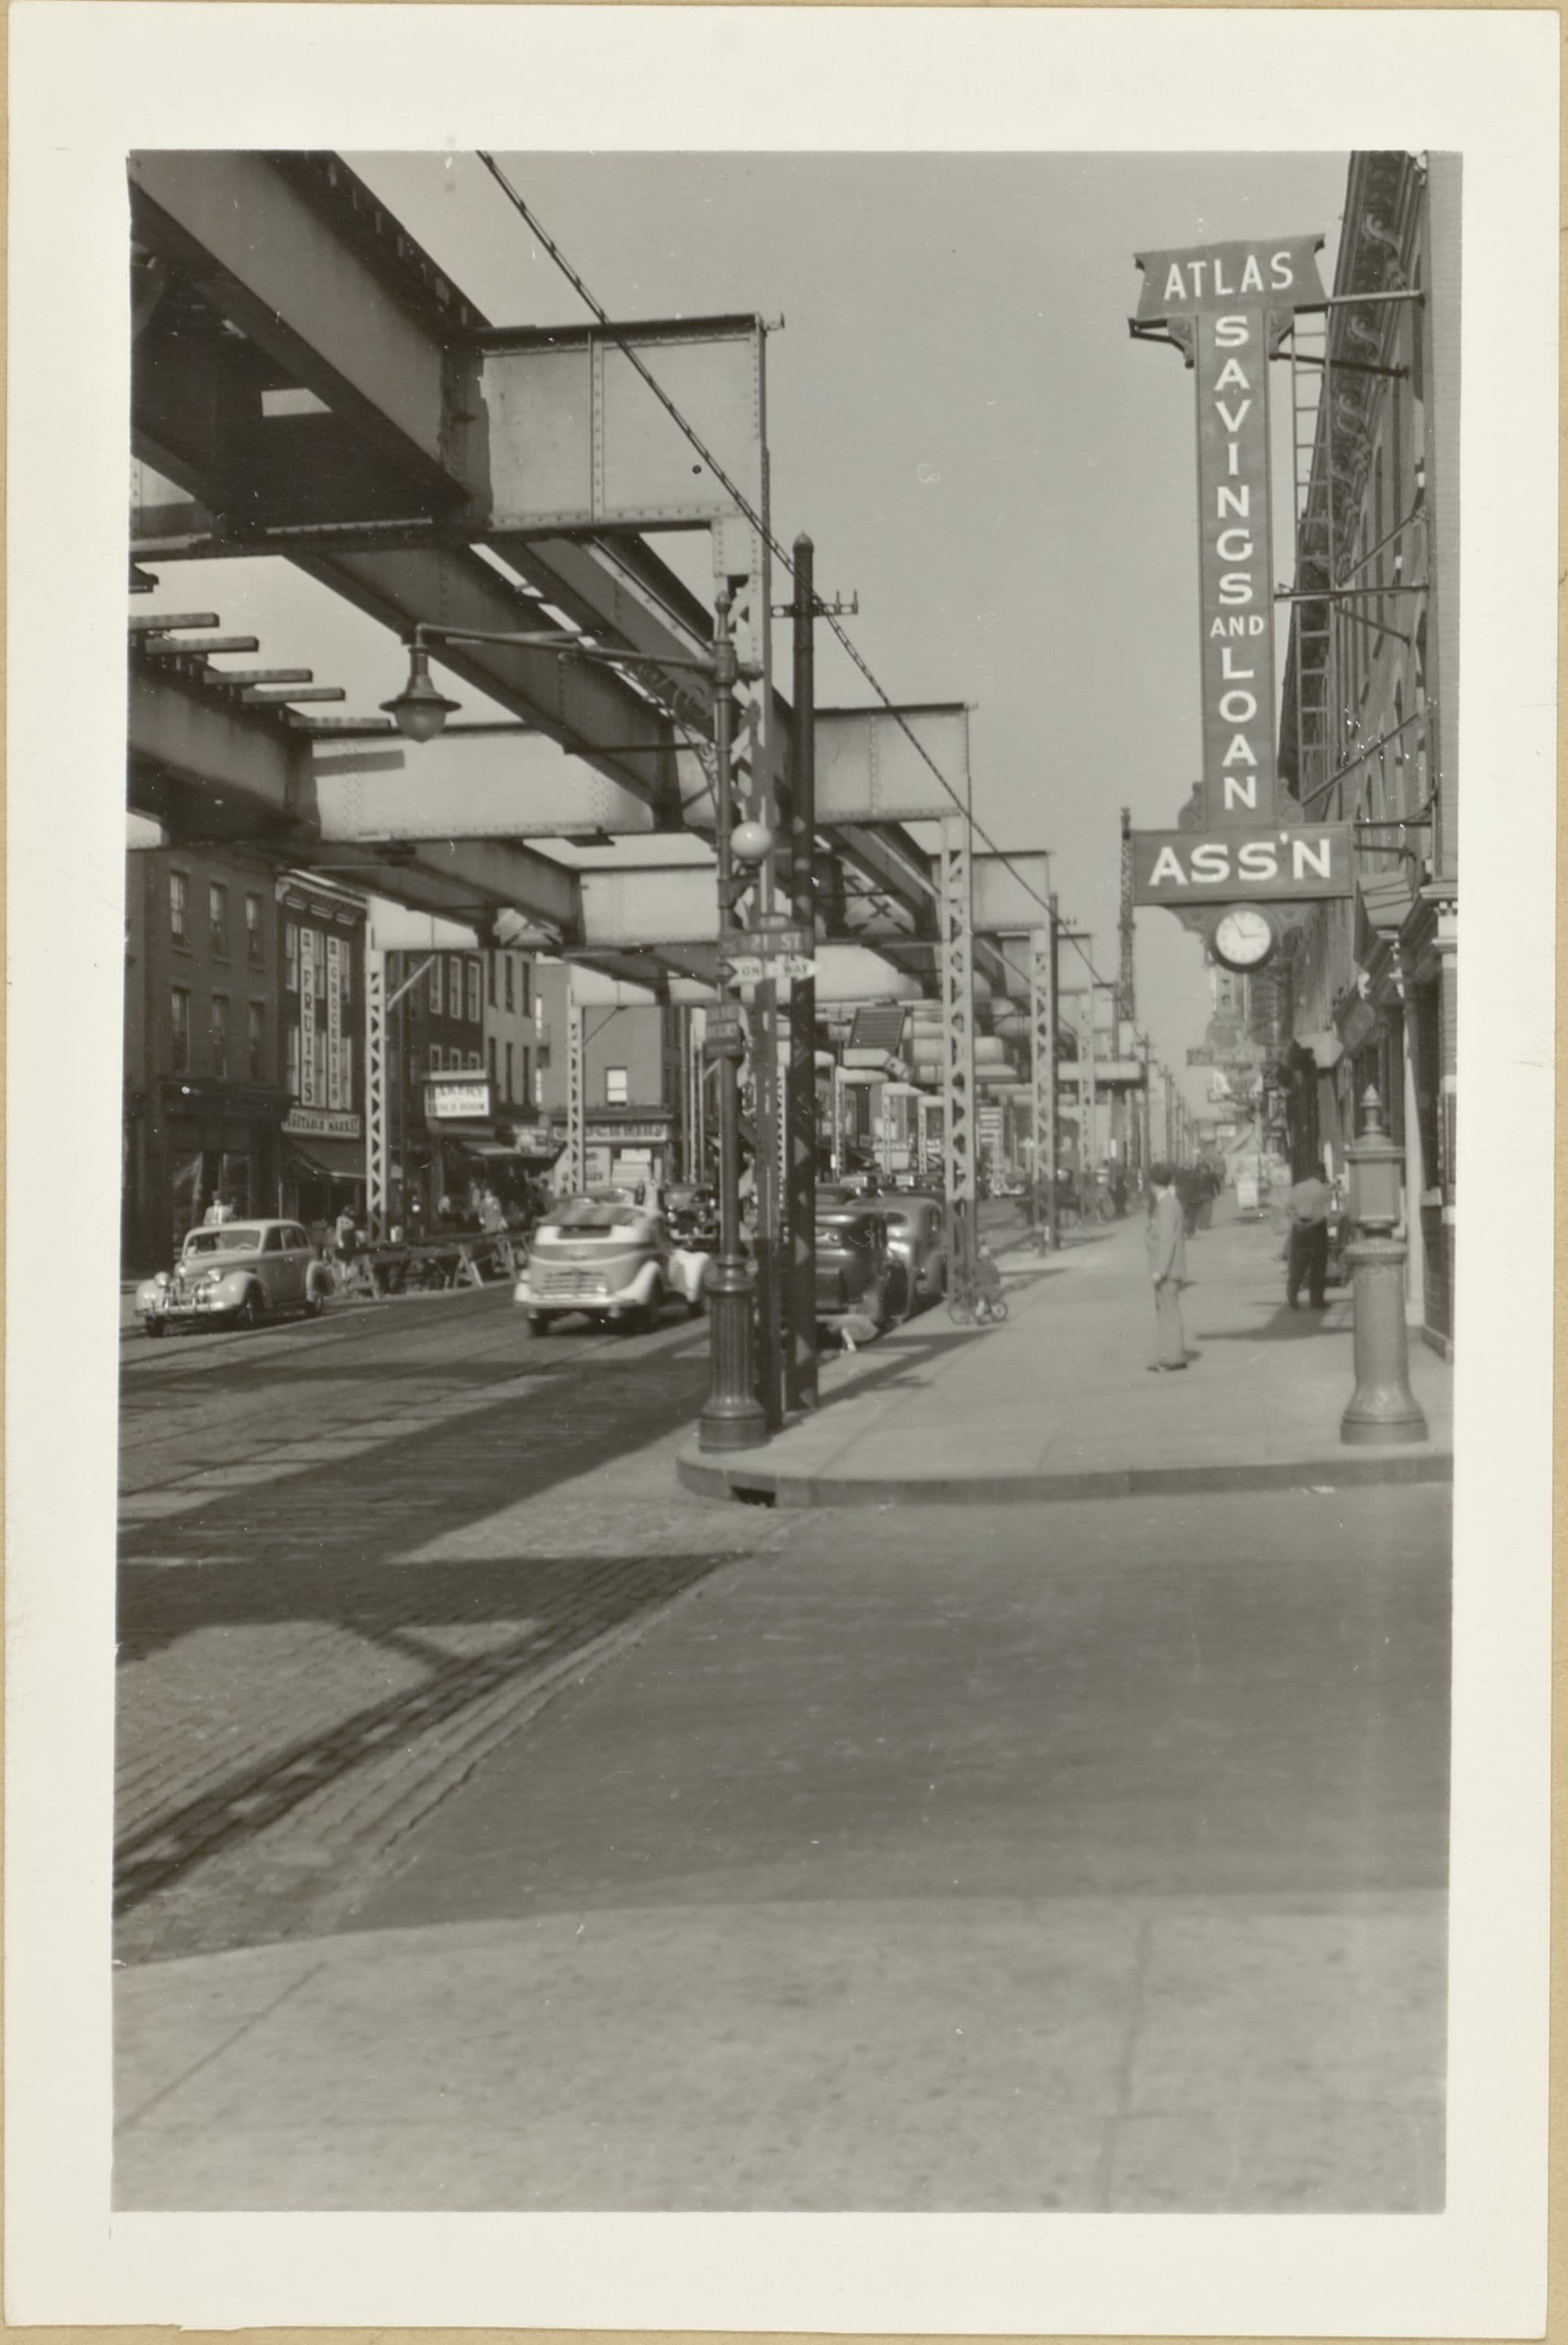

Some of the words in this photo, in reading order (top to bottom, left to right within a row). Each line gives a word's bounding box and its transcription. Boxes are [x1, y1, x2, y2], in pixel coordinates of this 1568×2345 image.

[1163, 251, 1294, 301] ATLAS
[1213, 314, 1255, 606] SAVINGS
[1209, 614, 1266, 638] AND
[1218, 646, 1259, 810] LOAN
[1149, 831, 1332, 885] ASS'N
[303, 969, 313, 1103] FRUITS
[330, 966, 339, 1102] GROCERIES
